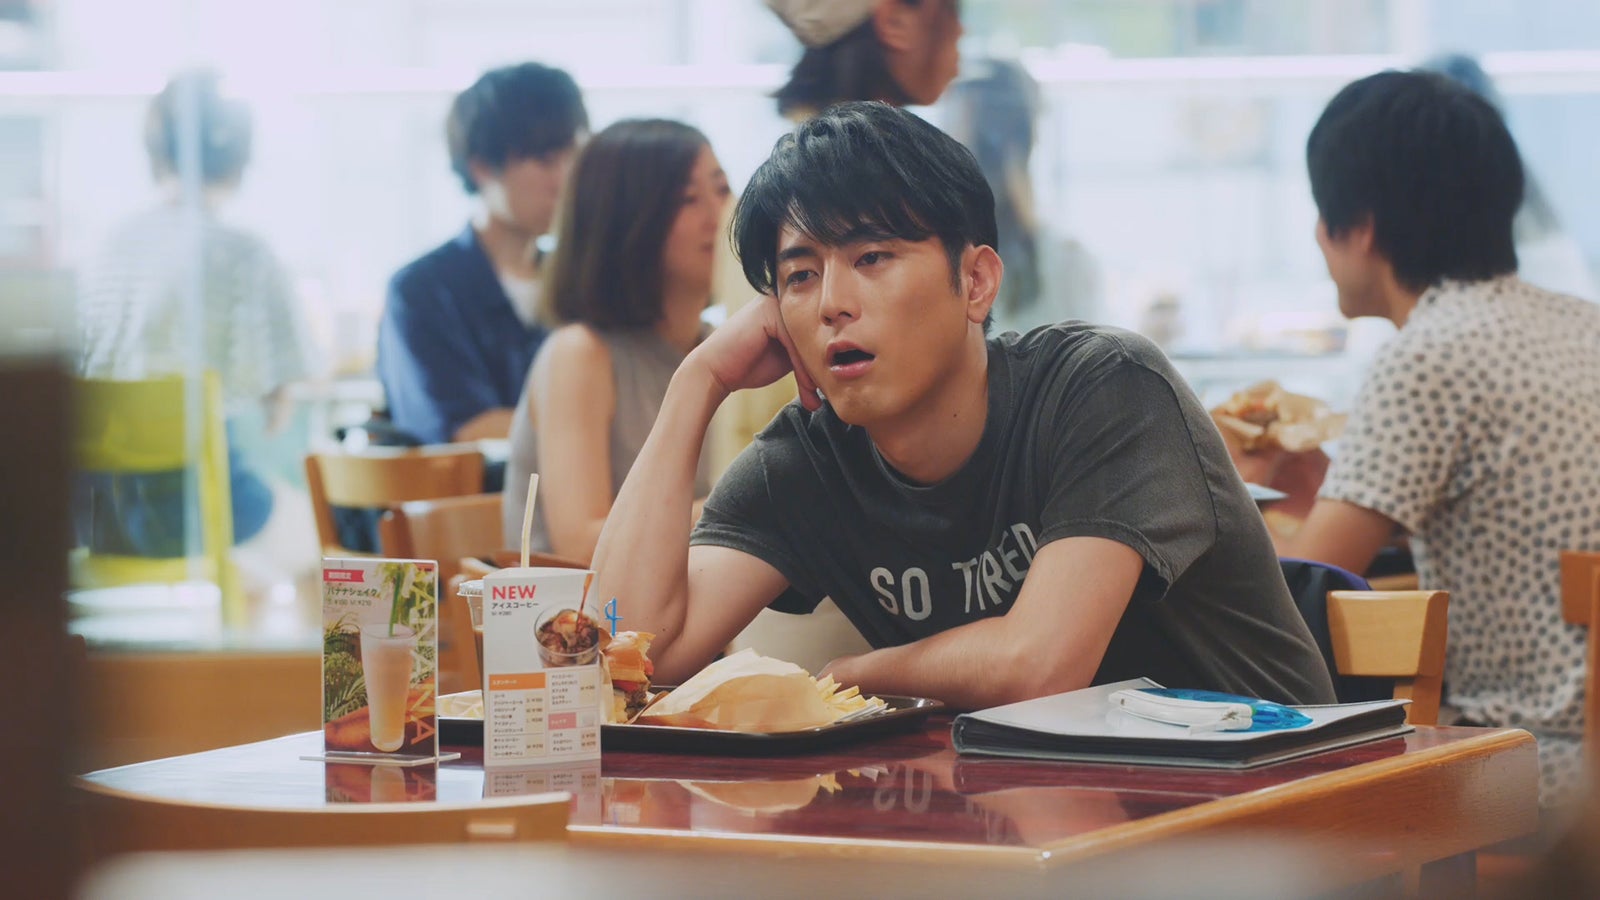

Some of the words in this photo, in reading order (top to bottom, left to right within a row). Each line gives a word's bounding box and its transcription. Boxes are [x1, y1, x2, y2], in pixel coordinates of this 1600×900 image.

[492, 584, 537, 600] NEW
[870, 566, 933, 621] SO
[952, 522, 1039, 614] TIRED
